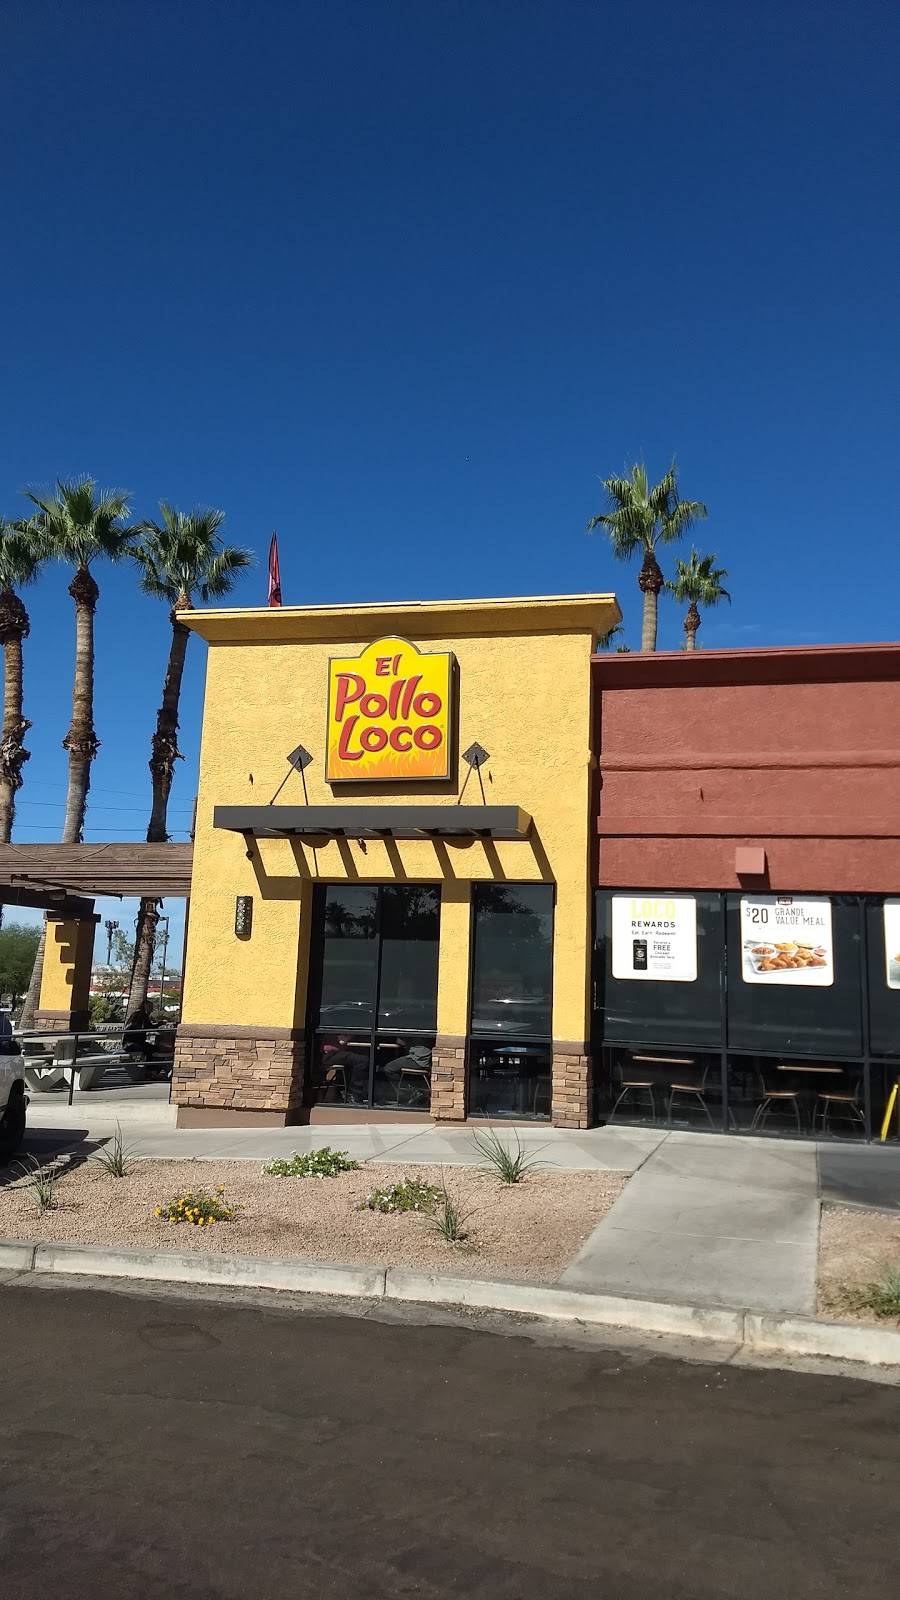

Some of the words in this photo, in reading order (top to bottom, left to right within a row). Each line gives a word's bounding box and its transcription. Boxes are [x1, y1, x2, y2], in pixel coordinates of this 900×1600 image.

[376, 653, 403, 676] El
[334, 672, 442, 722] Pollo
[338, 715, 443, 761] Loco
[631, 898, 676, 919] LOCO
[746, 907, 769, 924] $20
[774, 907, 805, 917] GRANDE
[631, 920, 676, 928] REWARDS
[775, 916, 800, 925] VALUE
[803, 917, 826, 926] MEAL
